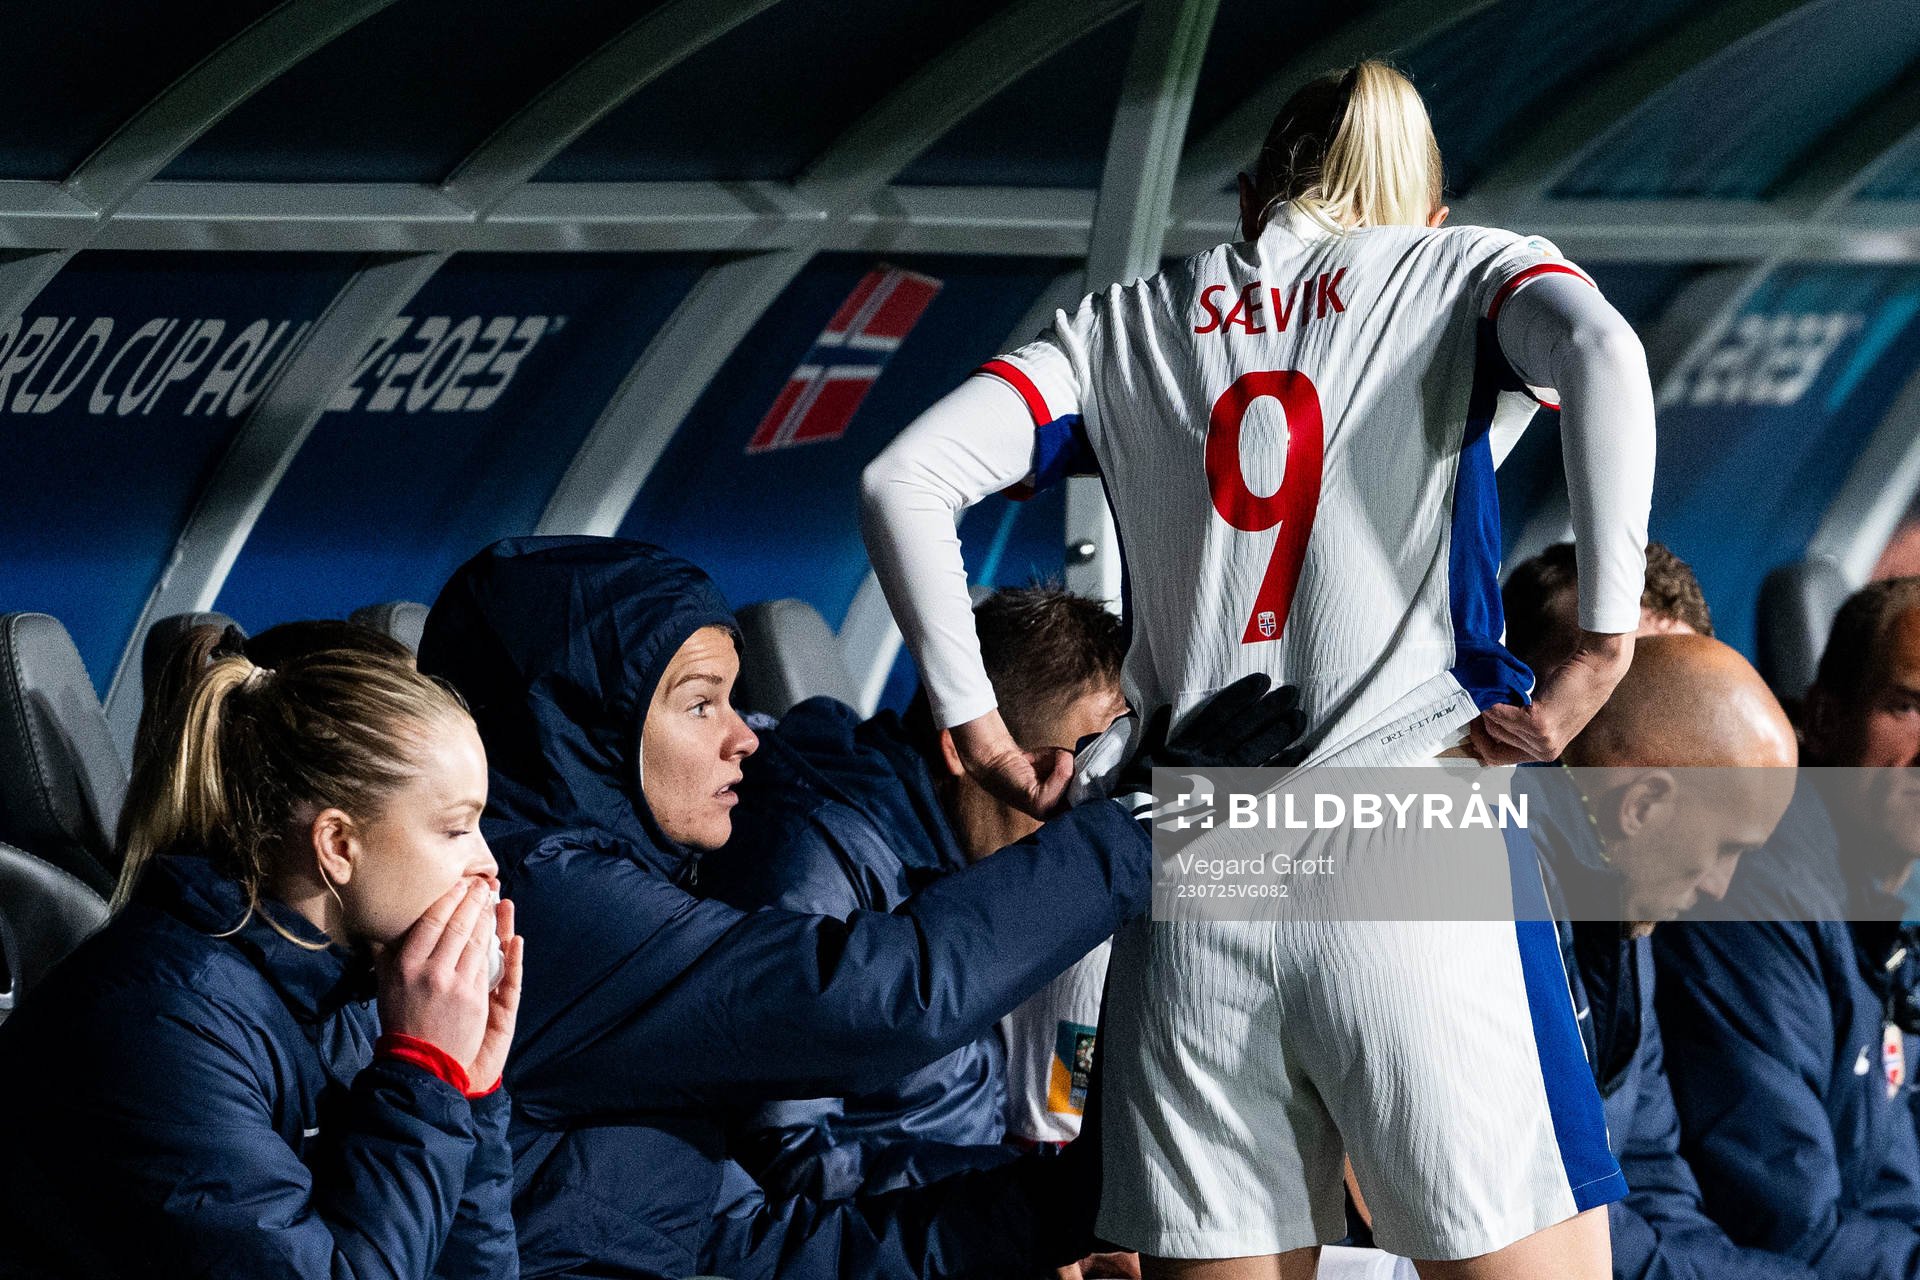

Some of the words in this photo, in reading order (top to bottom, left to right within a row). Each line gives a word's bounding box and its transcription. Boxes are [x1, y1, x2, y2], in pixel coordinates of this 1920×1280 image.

[1194, 266, 1348, 335] SÆVIK
[88, 317, 226, 416] CUP
[1204, 370, 1324, 645] 9
